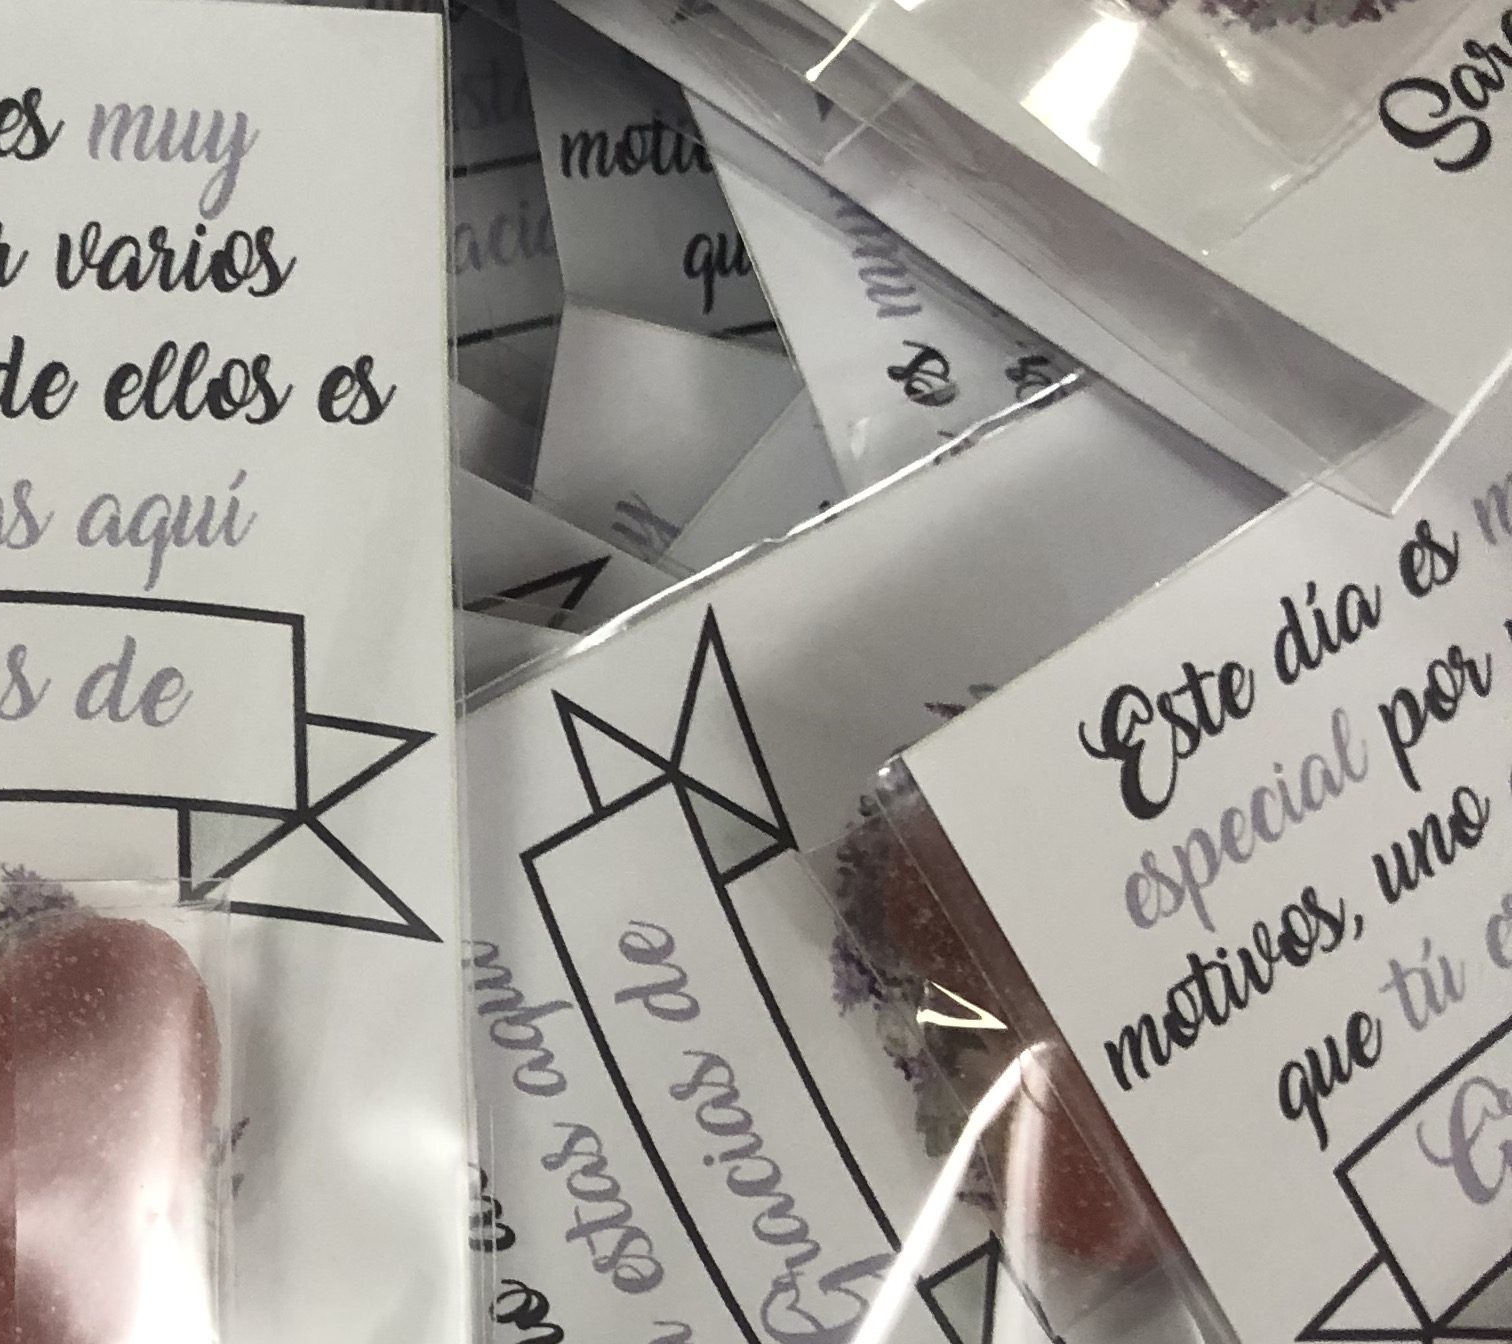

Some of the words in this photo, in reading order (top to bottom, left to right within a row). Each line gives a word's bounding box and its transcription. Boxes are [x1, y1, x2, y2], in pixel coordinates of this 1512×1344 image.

[87, 99, 261, 219] muy
[55, 215, 297, 298] varios
[682, 226, 754, 315] qu
[102, 340, 293, 425] ellos
[316, 352, 397, 425] es
[74, 469, 259, 591] aquí
[72, 636, 192, 728] de
[1078, 660, 1255, 822] Este
[1273, 580, 1382, 686] día
[1398, 518, 1460, 598] es
[1124, 706, 1369, 932] especial
[1376, 644, 1492, 793] por
[614, 918, 701, 1024] de
[1103, 884, 1364, 1092] motivos,
[1370, 784, 1491, 908] uno
[1277, 1009, 1383, 1152] que
[1378, 937, 1467, 1032] tú
[540, 1122, 665, 1296] estas
